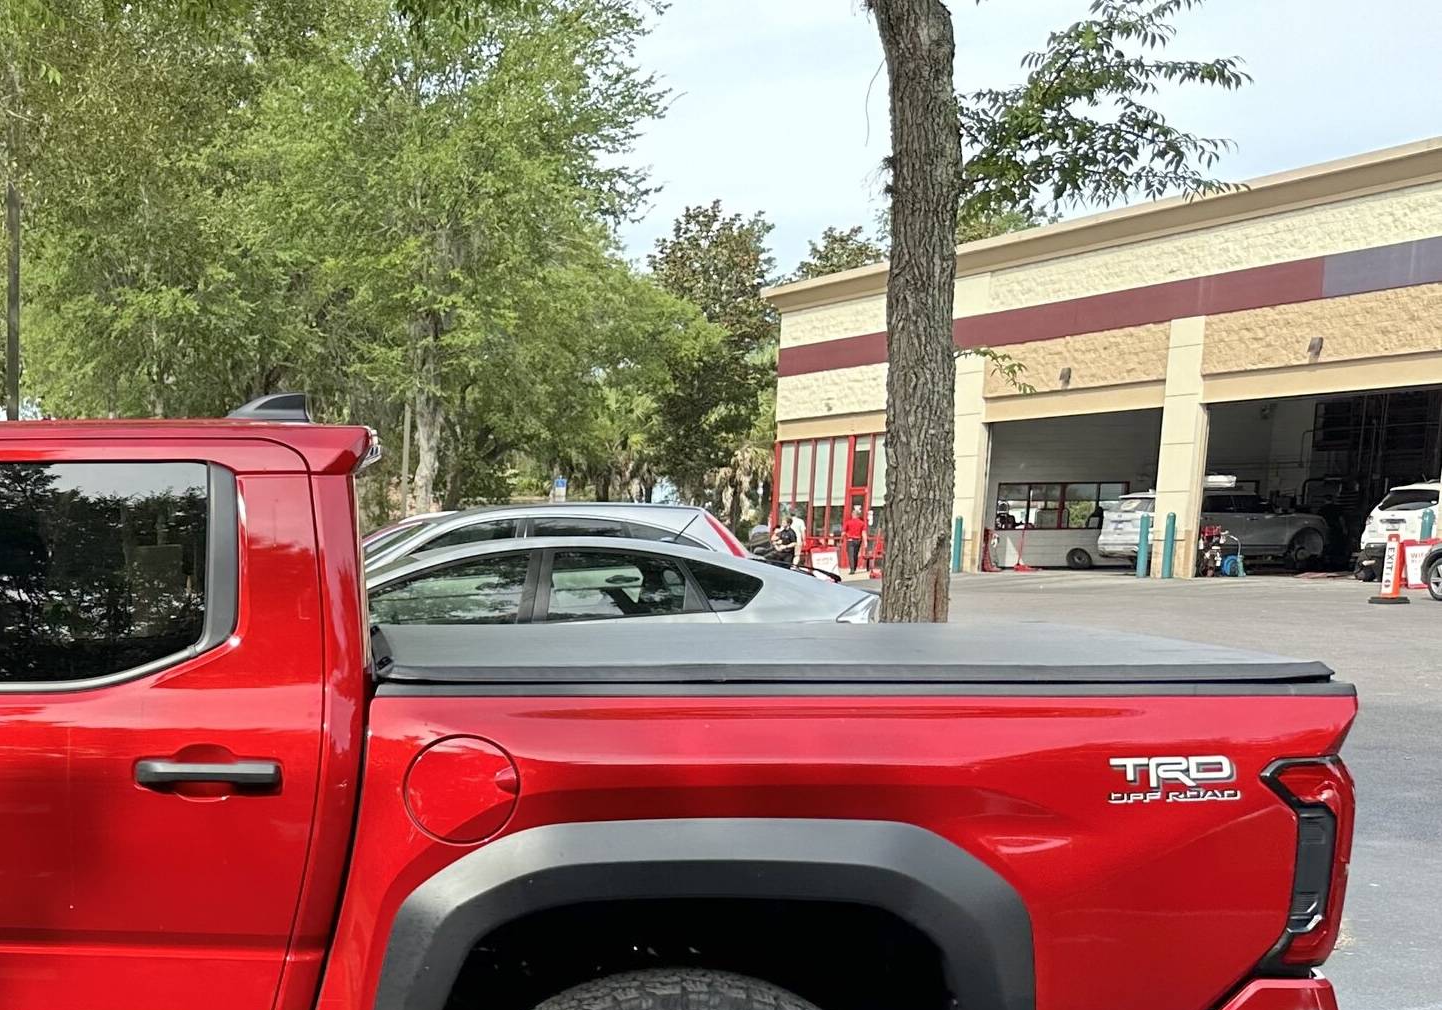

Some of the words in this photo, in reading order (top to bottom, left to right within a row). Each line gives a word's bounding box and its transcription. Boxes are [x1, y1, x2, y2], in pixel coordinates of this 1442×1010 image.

[1386, 548, 1396, 570] EXIT
[1109, 755, 1234, 788] TRD
[1108, 791, 1161, 804] OFF
[1166, 789, 1242, 803] ROAD
